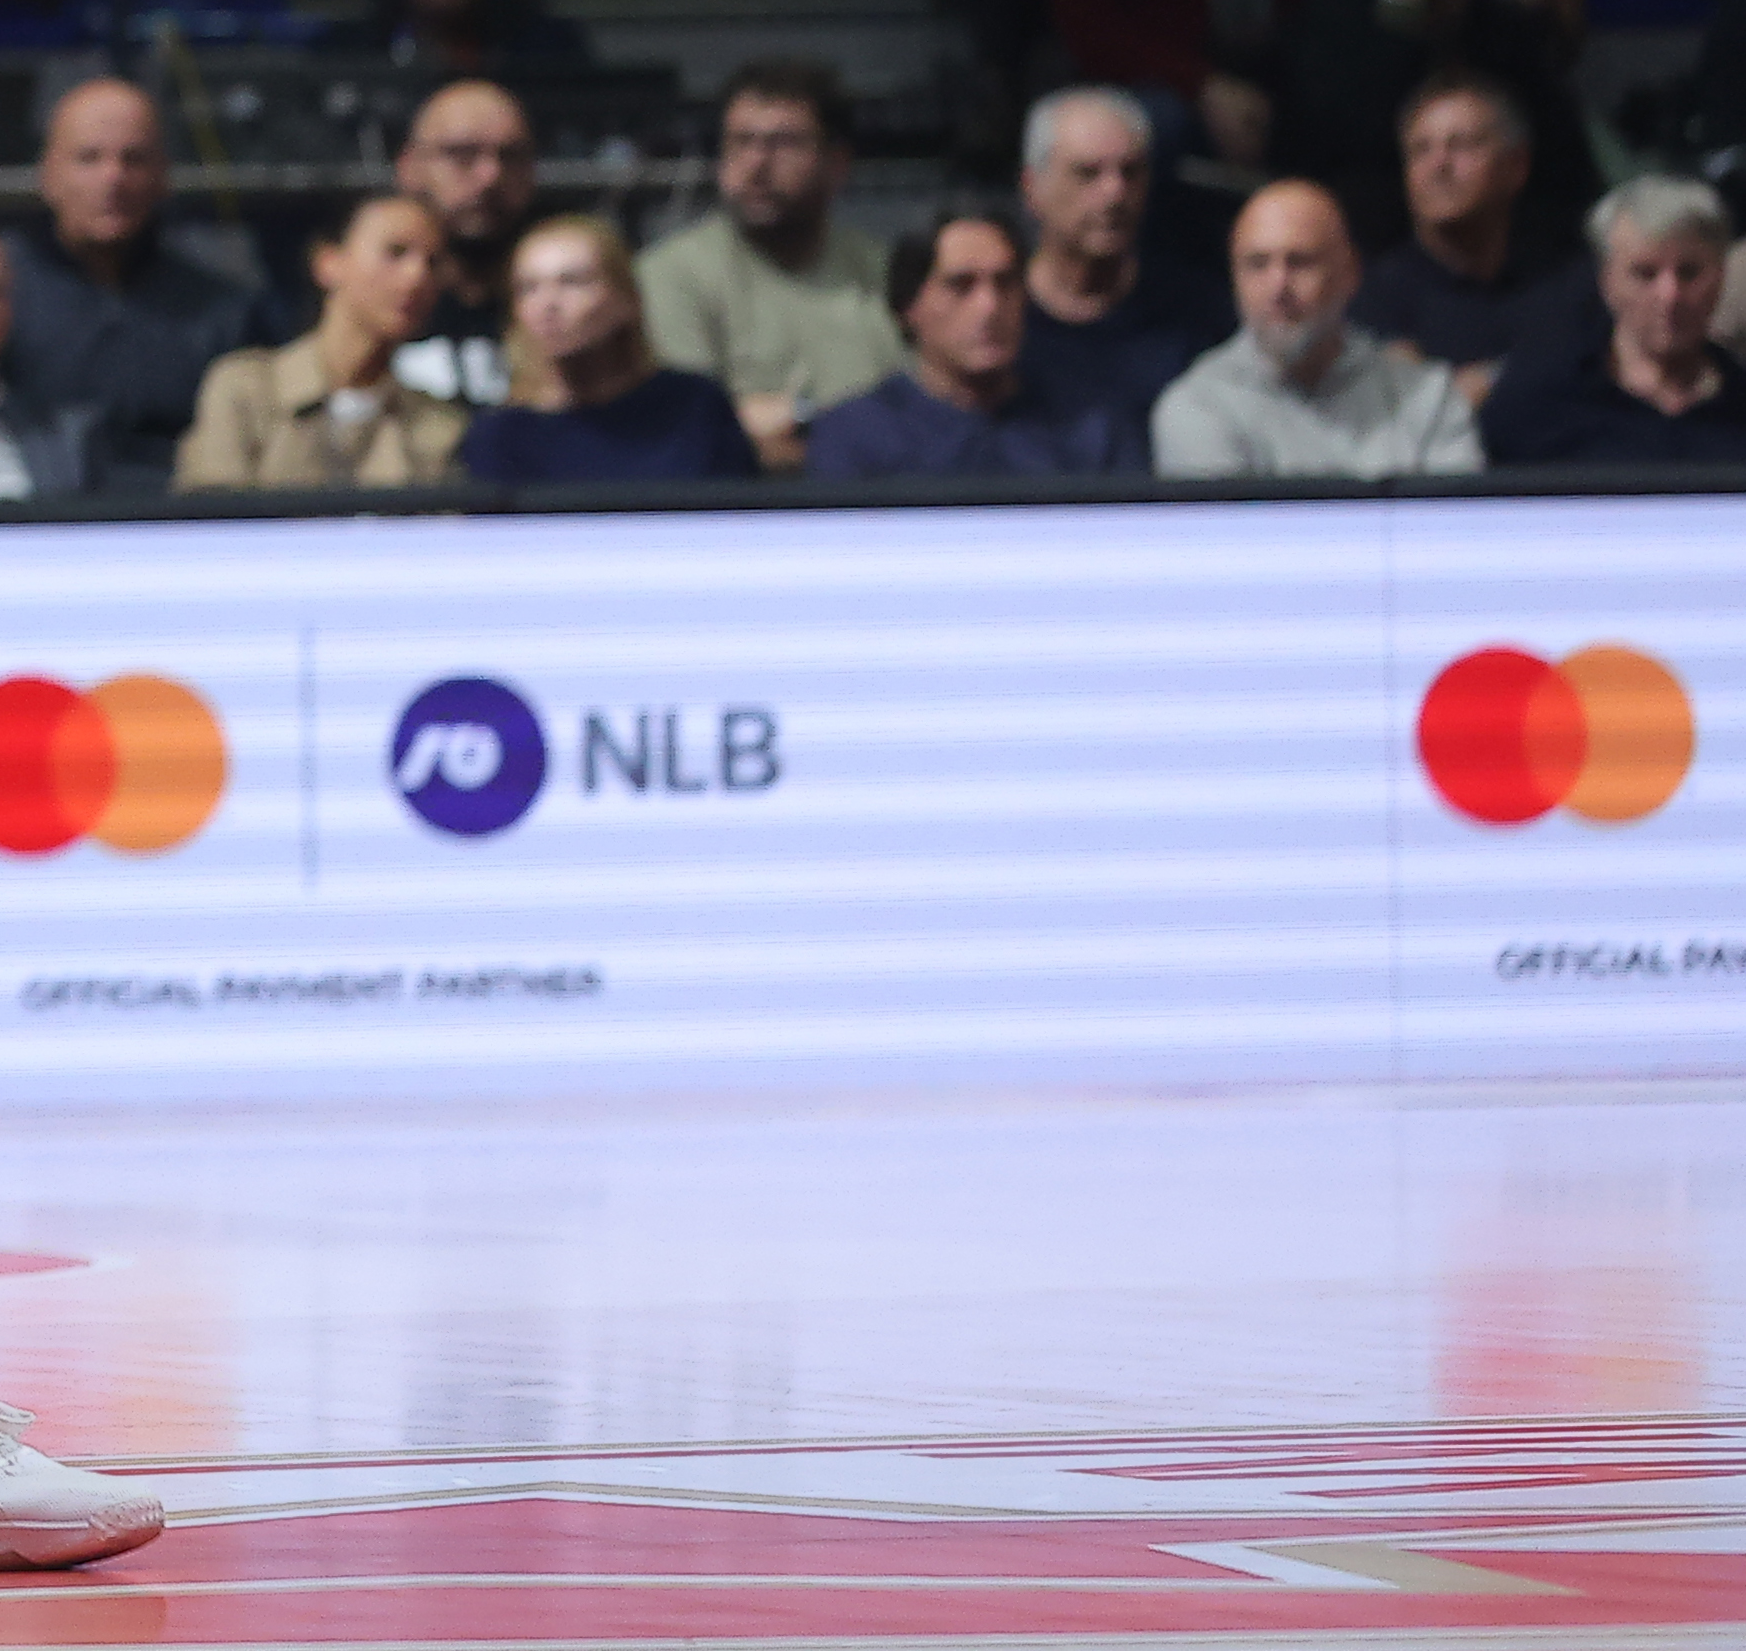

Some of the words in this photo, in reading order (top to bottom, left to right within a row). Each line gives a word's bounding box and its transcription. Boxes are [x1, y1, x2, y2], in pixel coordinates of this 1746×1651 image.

[584, 711, 778, 793] NLB
[1496, 942, 1674, 980] OFFICIAL
[20, 972, 202, 1011] OFFICIAL
[415, 963, 603, 1000] PARTNER
